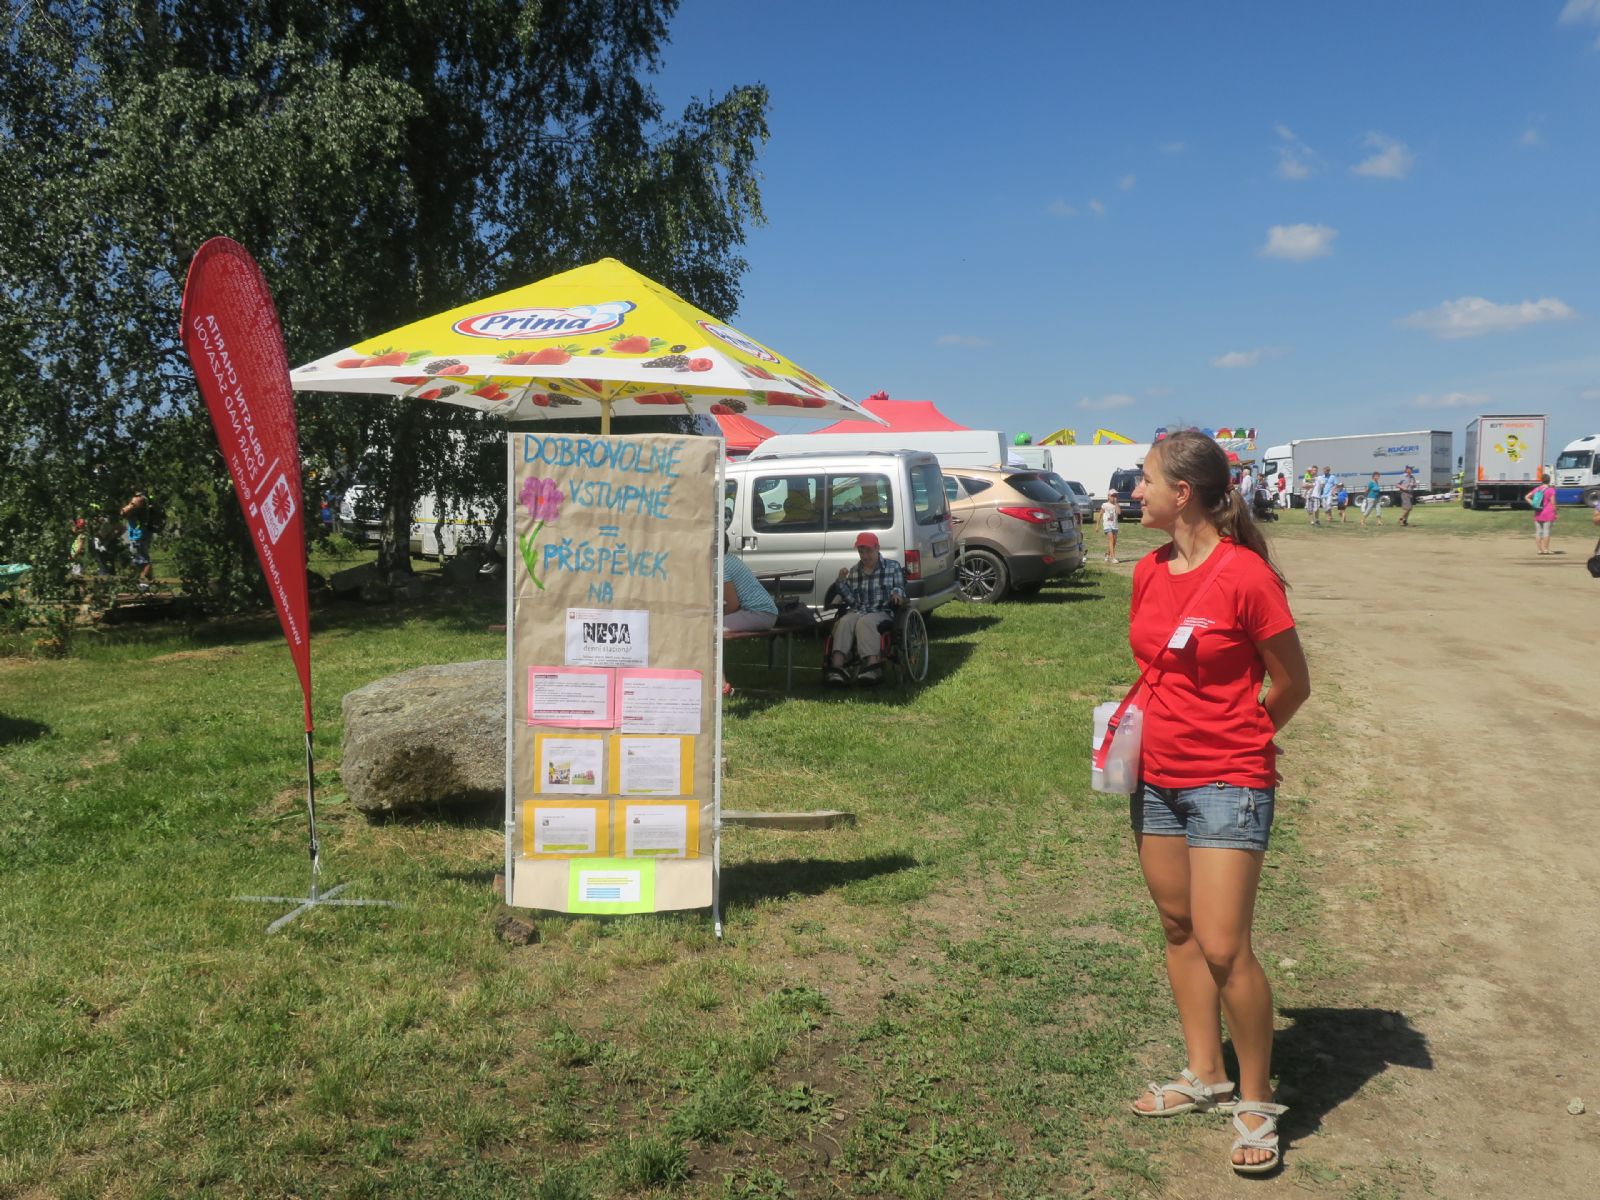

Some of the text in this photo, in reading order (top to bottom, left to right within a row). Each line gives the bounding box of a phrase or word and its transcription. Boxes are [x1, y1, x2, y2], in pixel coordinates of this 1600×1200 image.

[480, 314, 592, 331] Prima
[524, 433, 685, 478] DOBROVOLNÉ
[569, 480, 672, 519] VSTUPNÉ
[543, 538, 671, 580] PŘÍSPĚVEK
[588, 582, 613, 604] NA
[583, 622, 631, 644] NESA
